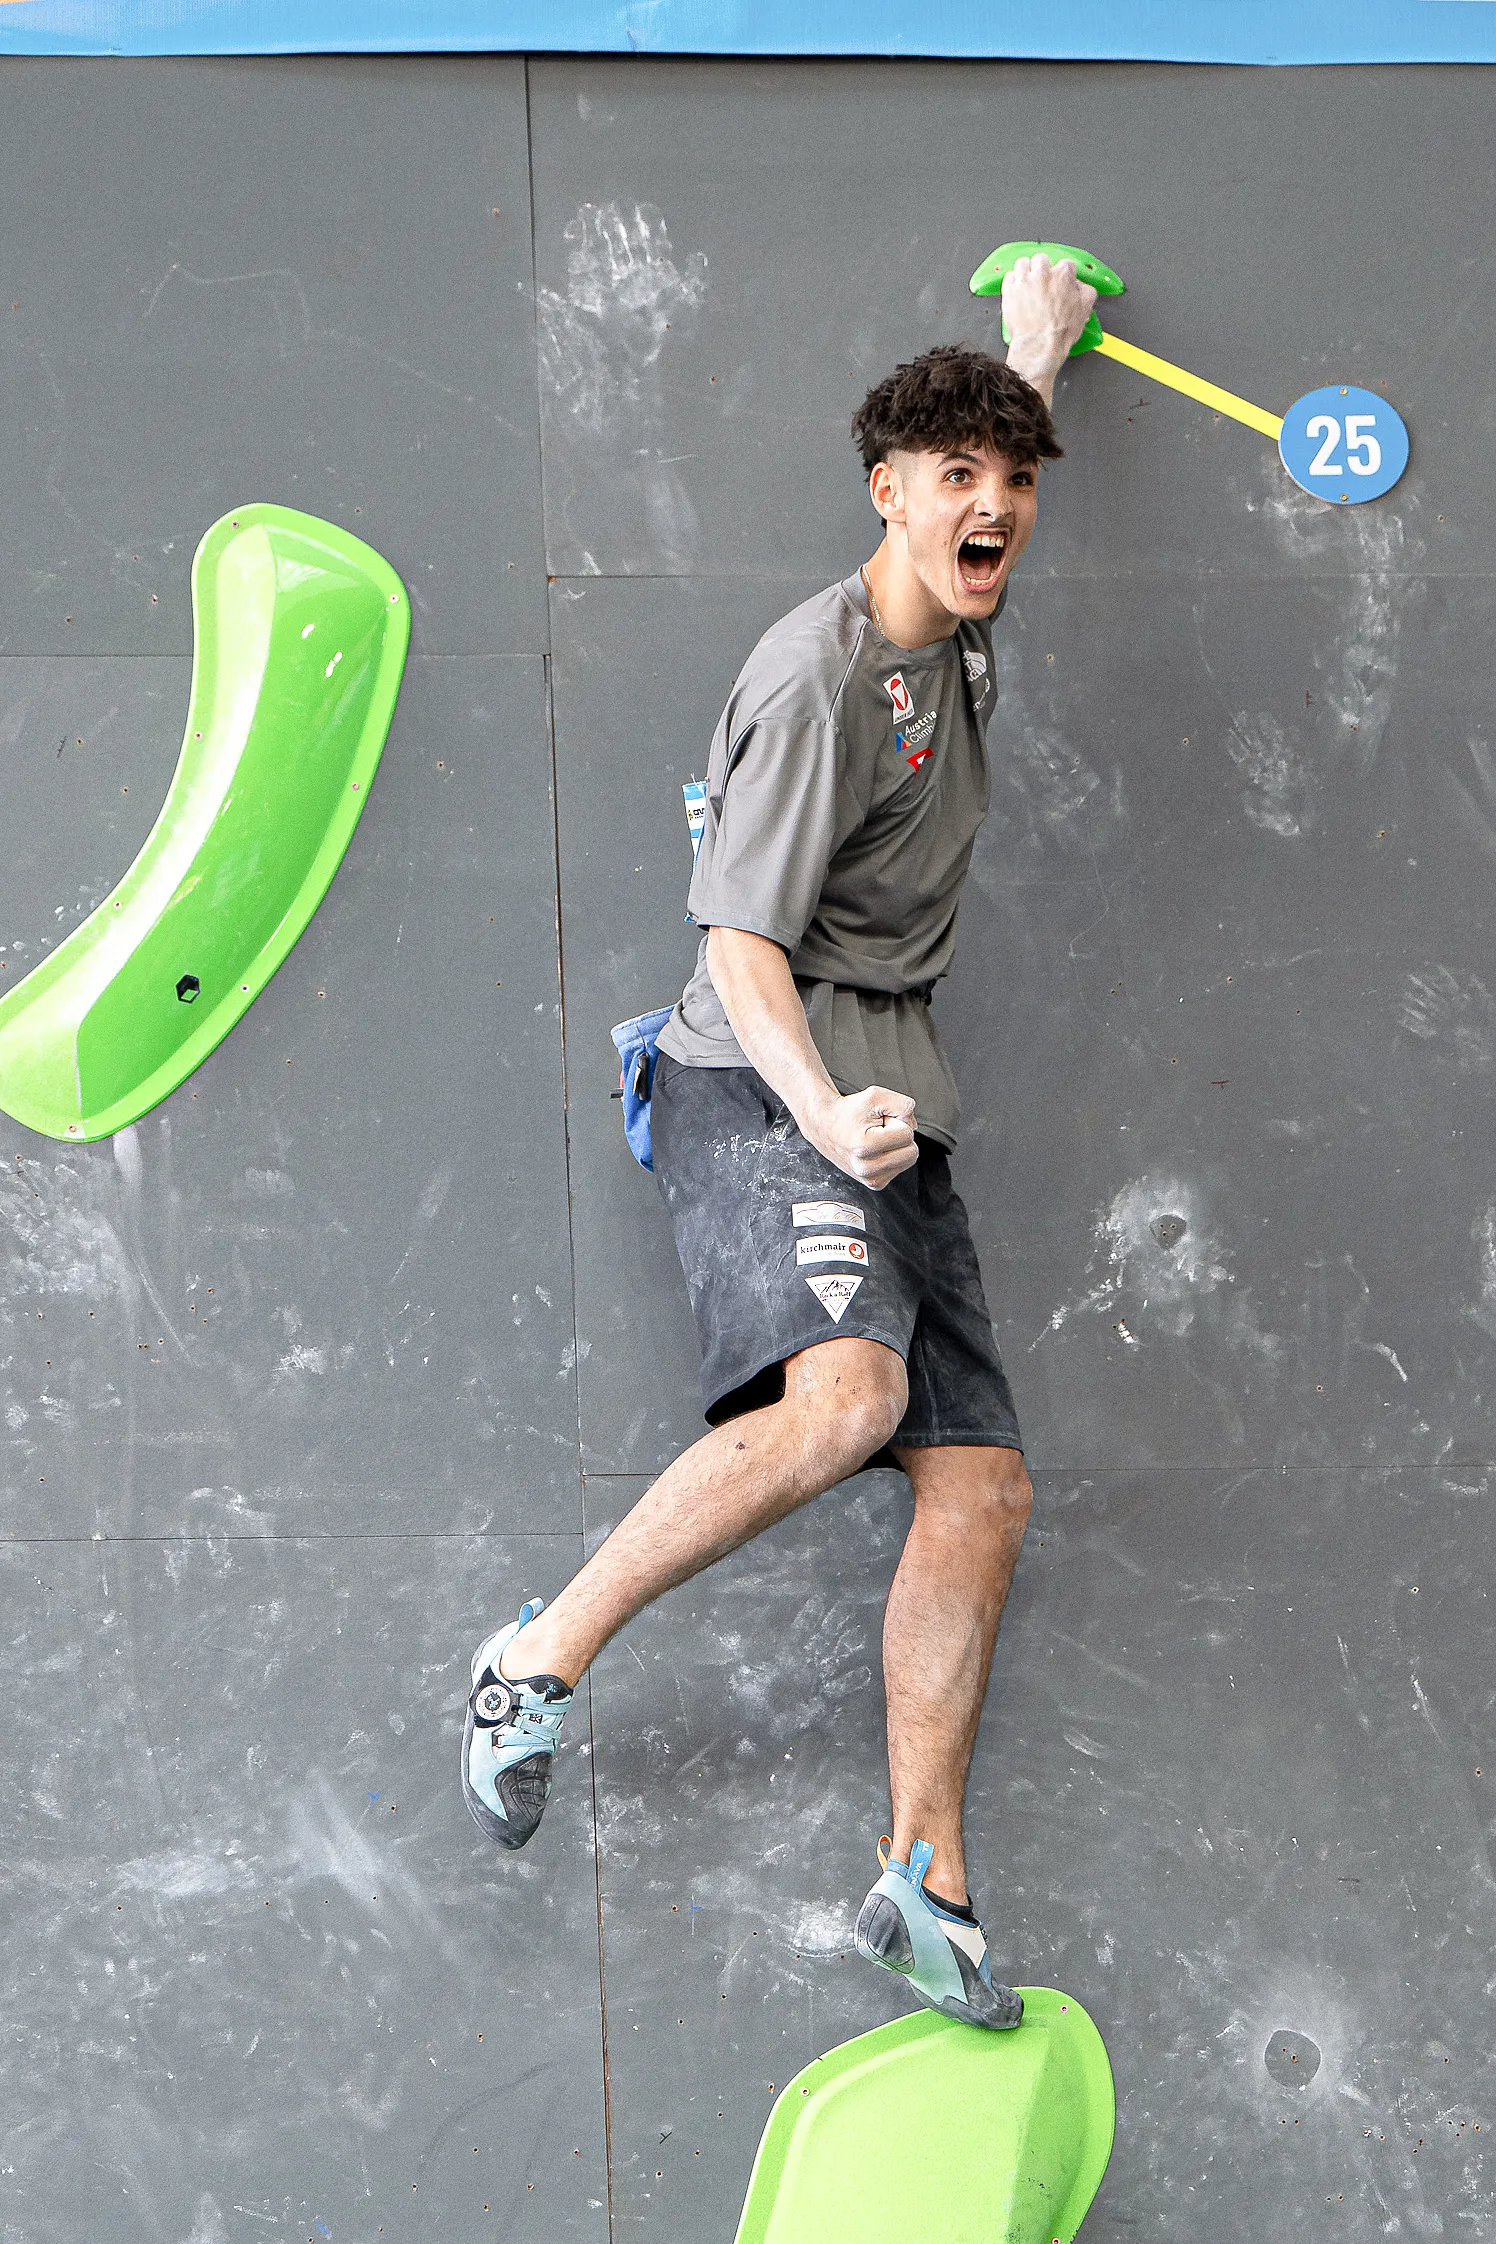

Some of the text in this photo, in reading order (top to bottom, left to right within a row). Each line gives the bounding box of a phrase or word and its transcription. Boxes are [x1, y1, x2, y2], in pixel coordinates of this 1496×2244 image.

[1306, 415, 1382, 476] 25
[905, 711, 938, 736] Austria
[800, 1242, 847, 1254] kirchmair
